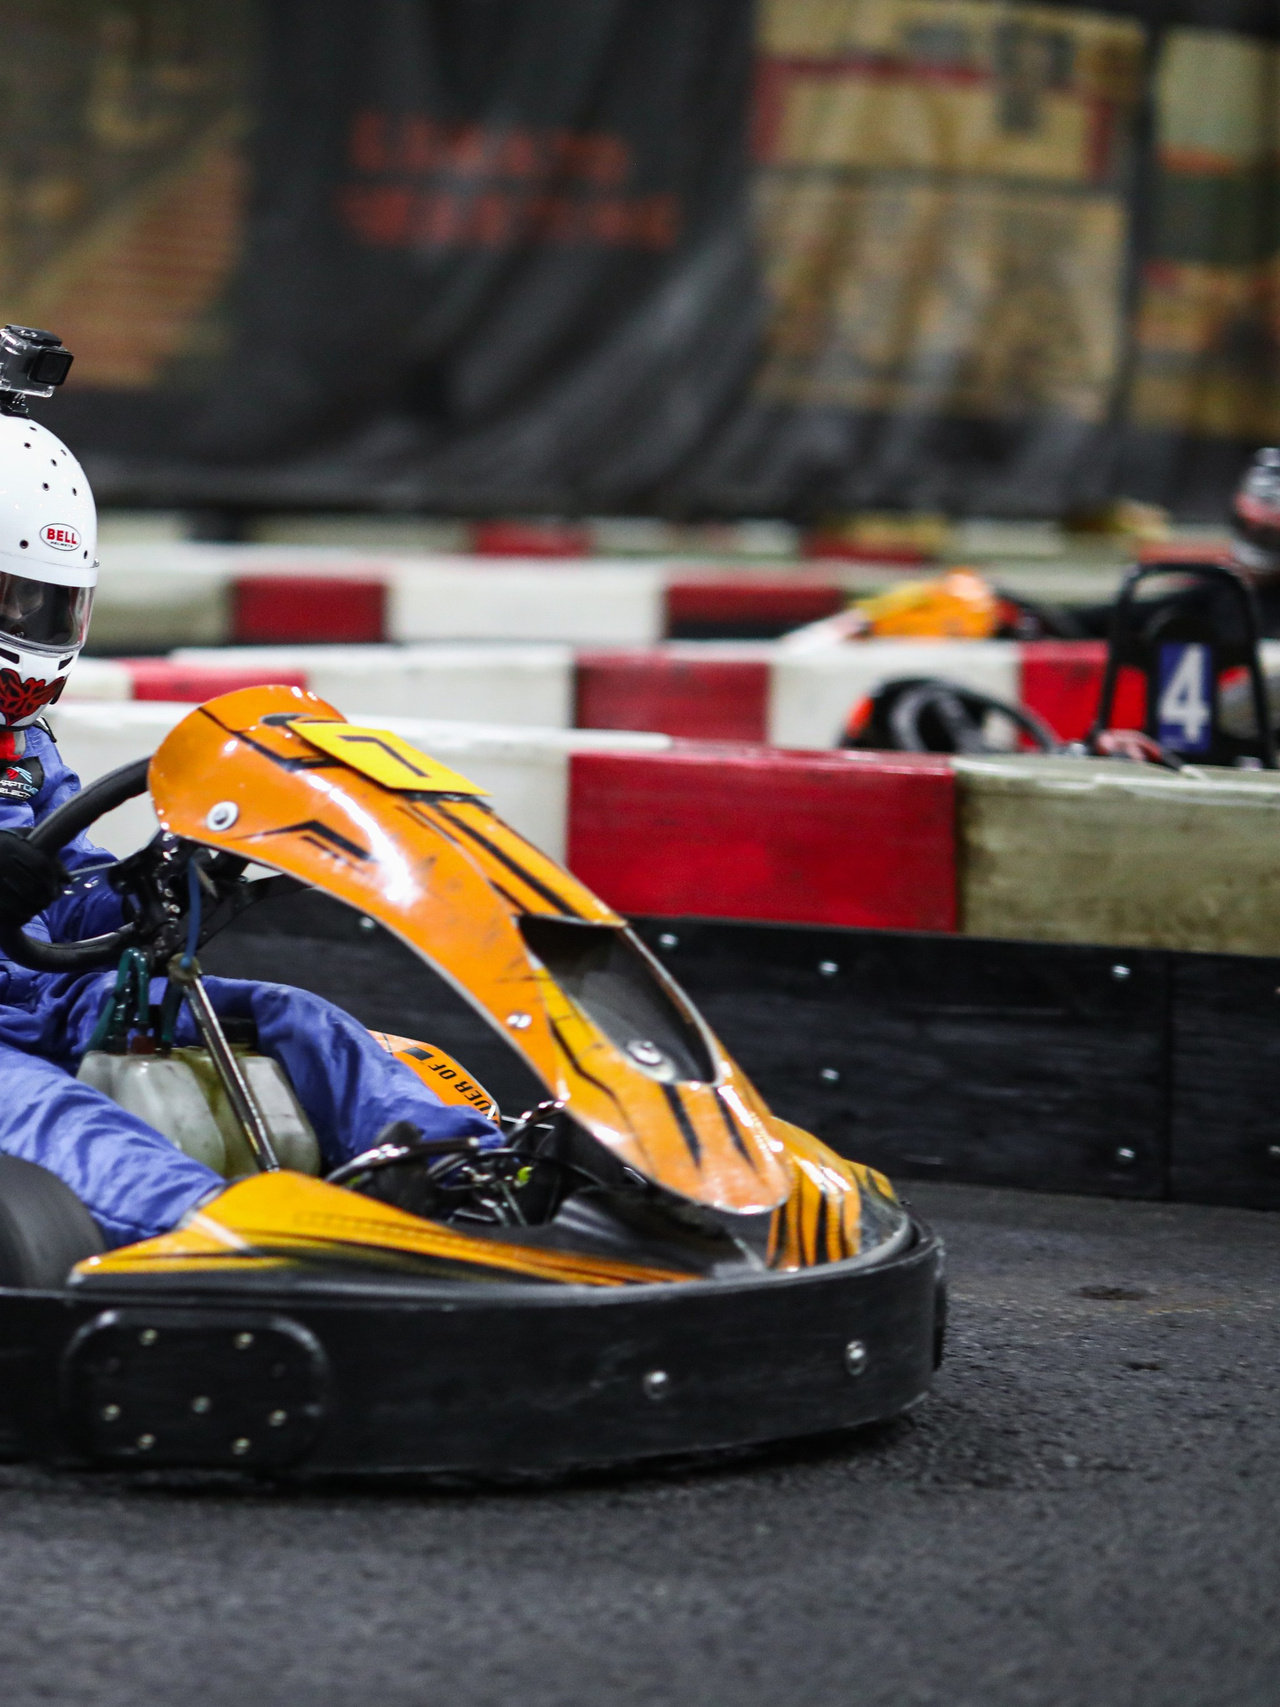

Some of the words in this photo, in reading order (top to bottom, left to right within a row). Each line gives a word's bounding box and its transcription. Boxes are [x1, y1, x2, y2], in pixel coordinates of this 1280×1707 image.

[47, 528, 77, 545] BELL
[1158, 642, 1209, 744] 4
[337, 734, 431, 778] 7
[428, 1064, 457, 1080] OF
